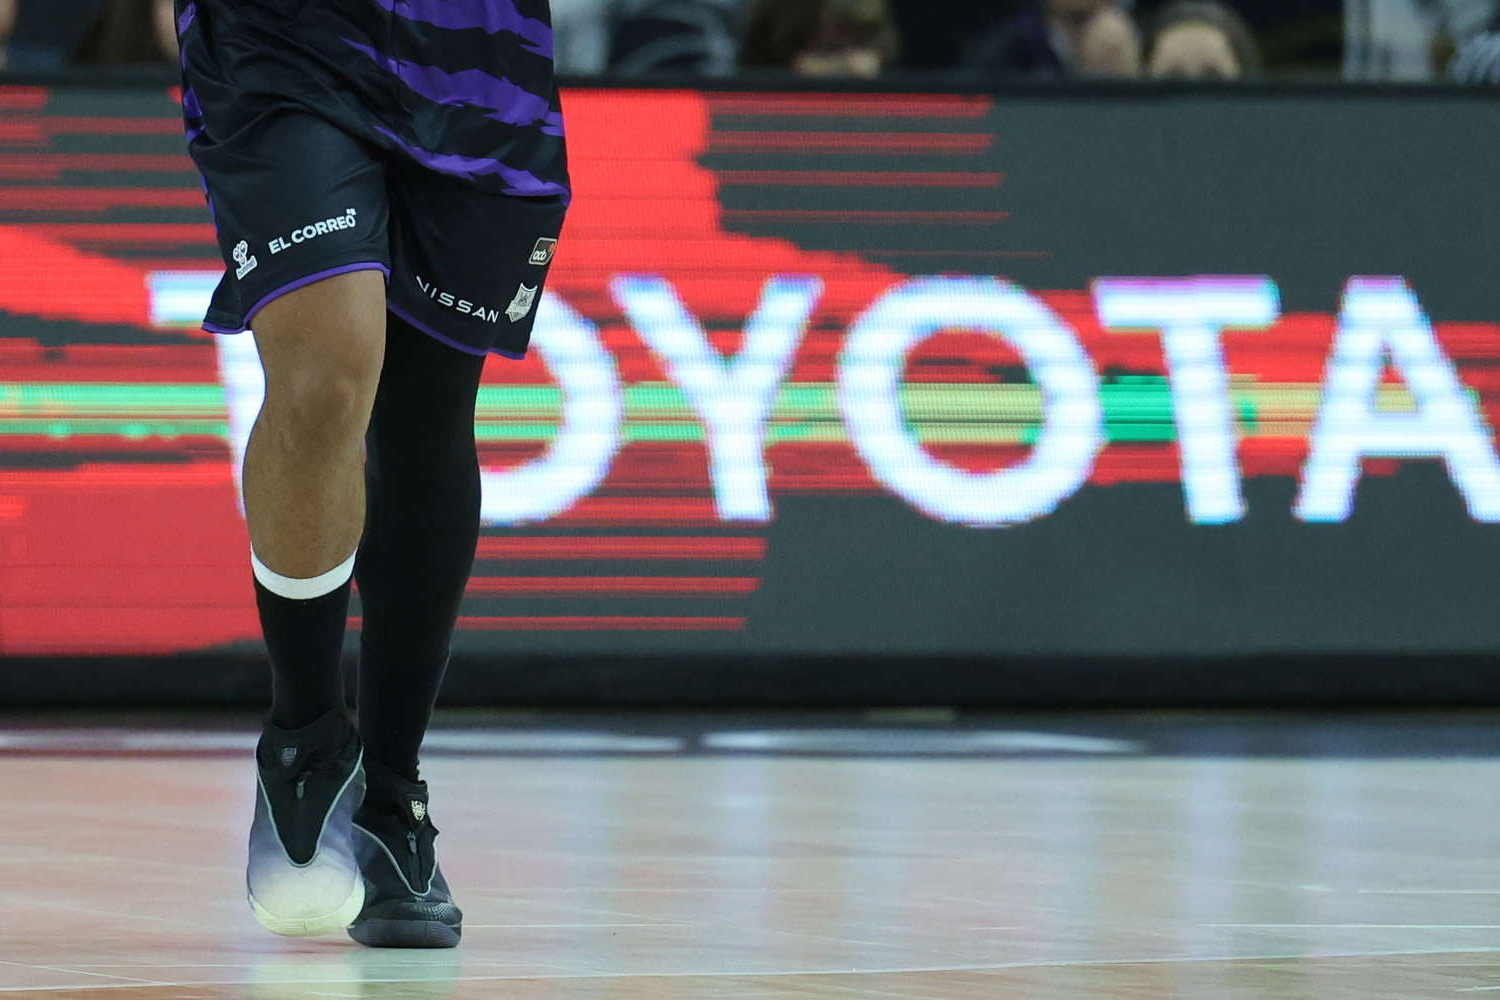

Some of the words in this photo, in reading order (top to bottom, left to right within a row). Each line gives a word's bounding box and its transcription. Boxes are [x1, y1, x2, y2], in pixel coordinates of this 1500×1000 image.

[268, 236, 292, 255] EL
[291, 213, 357, 244] CORREO
[416, 275, 500, 323] NISSAN
